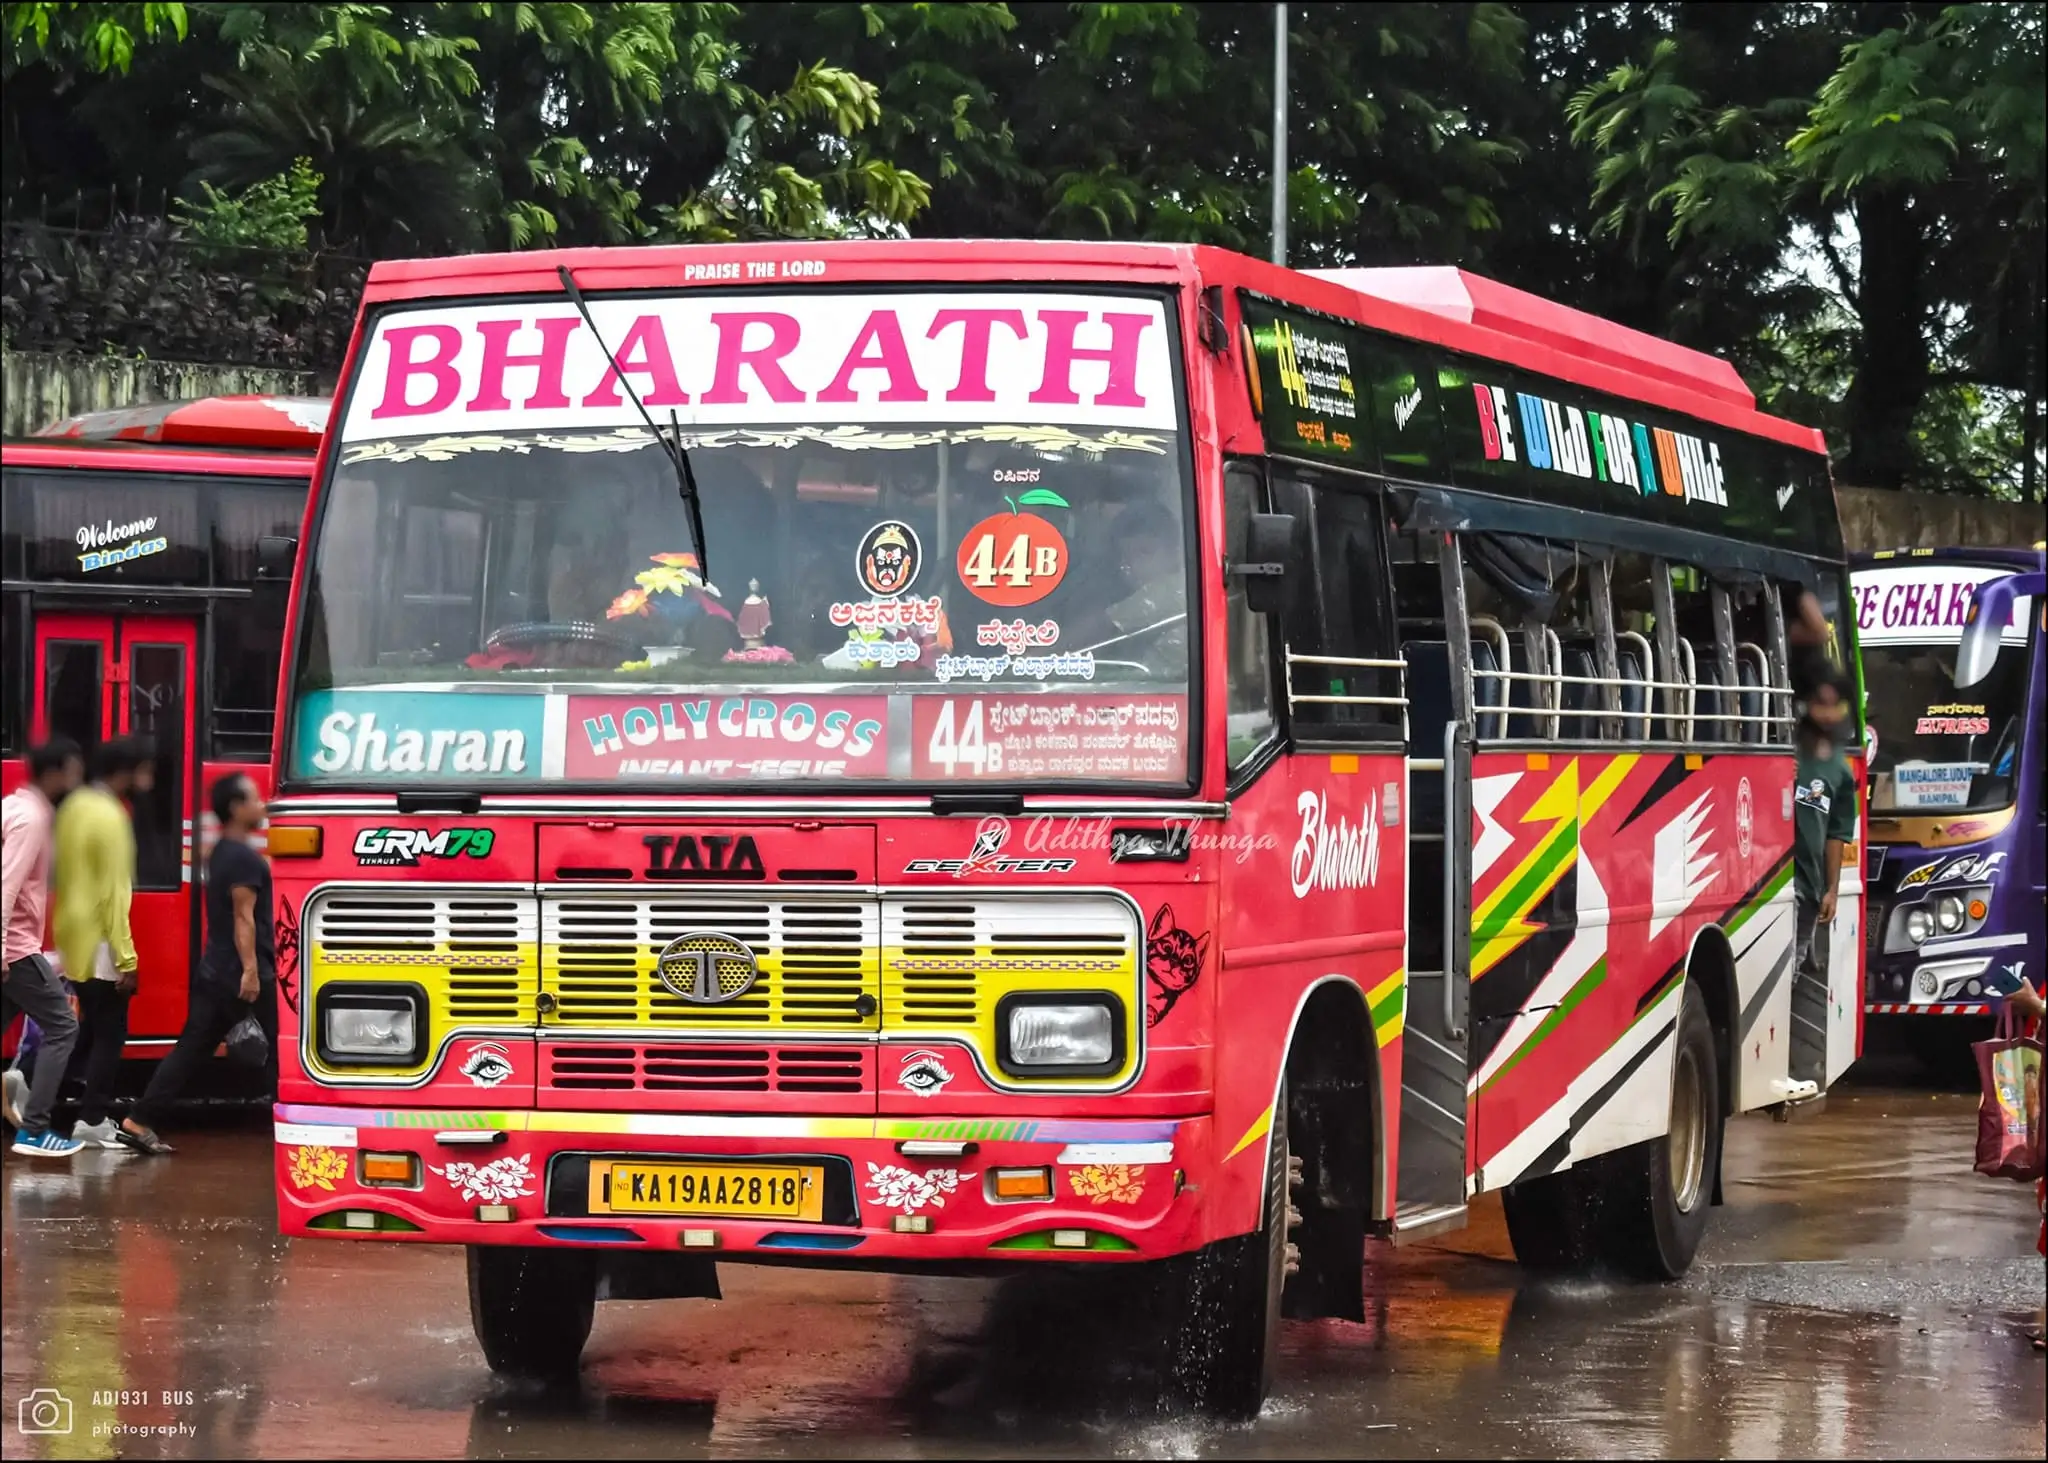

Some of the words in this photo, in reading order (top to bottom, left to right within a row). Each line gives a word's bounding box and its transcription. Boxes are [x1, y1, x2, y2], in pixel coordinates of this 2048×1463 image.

[685, 263, 741, 280] PRAISE
[747, 261, 775, 277] THE
[782, 260, 826, 276] LORD
[371, 308, 1154, 420] BHARATH
[1472, 383, 1517, 461] BE
[1516, 392, 1592, 479] WILD
[1587, 411, 1641, 495] FOR
[1633, 422, 1658, 496] A
[1653, 427, 1728, 507] WHILE
[76, 516, 157, 550] Welcome
[77, 536, 167, 572] Bindas
[963, 533, 1058, 587] 44B
[313, 712, 527, 775] Sharan
[1915, 717, 1989, 734] EXPRESS
[354, 828, 496, 858] GRM79
[643, 835, 766, 871] TATA
[1292, 787, 1379, 898] Bharath
[902, 856, 1078, 876] DEXTER
[631, 1173, 796, 1206] KA19AA2818
